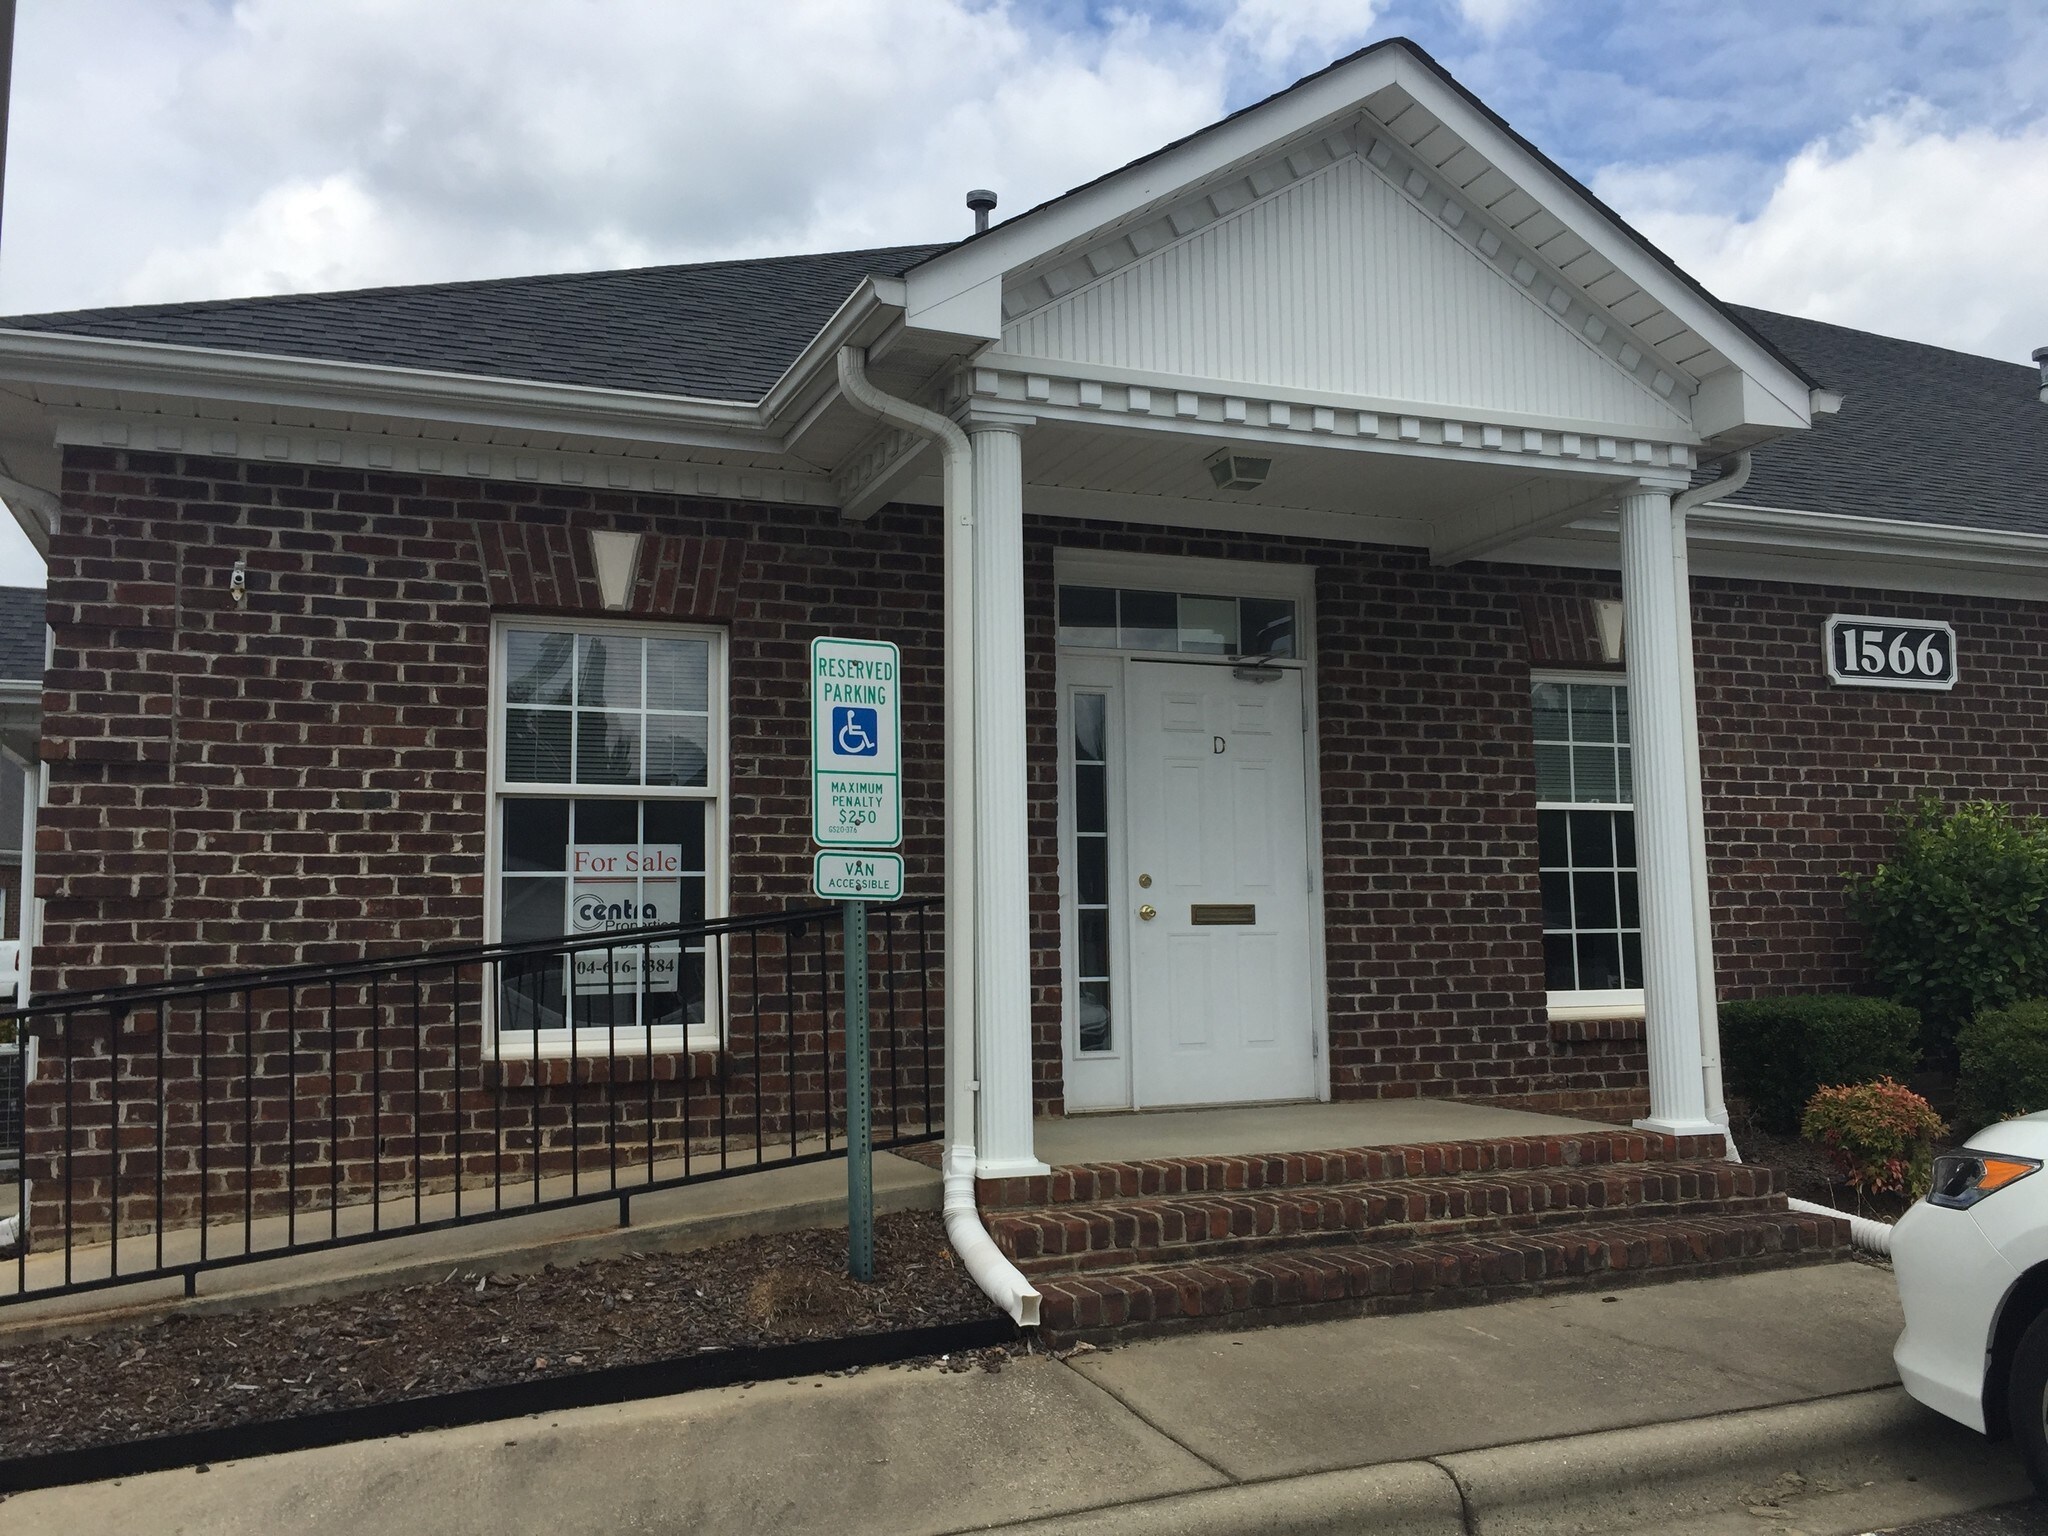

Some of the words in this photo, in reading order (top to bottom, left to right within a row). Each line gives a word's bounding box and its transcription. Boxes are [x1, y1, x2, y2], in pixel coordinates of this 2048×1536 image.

[1842, 629, 1943, 676] 1566
[819, 657, 892, 681] RESERVED
[824, 682, 886, 705] PARKING
[1213, 735, 1226, 754] D
[831, 781, 883, 794] MAXIMUM
[832, 795, 883, 808] PENALTY
[839, 808, 877, 825] $250
[574, 851, 617, 872] For
[625, 850, 677, 872] Sale
[845, 861, 875, 876] VAN
[828, 878, 890, 890] ACCESSIBLE
[574, 958, 675, 975] 04-616-384
